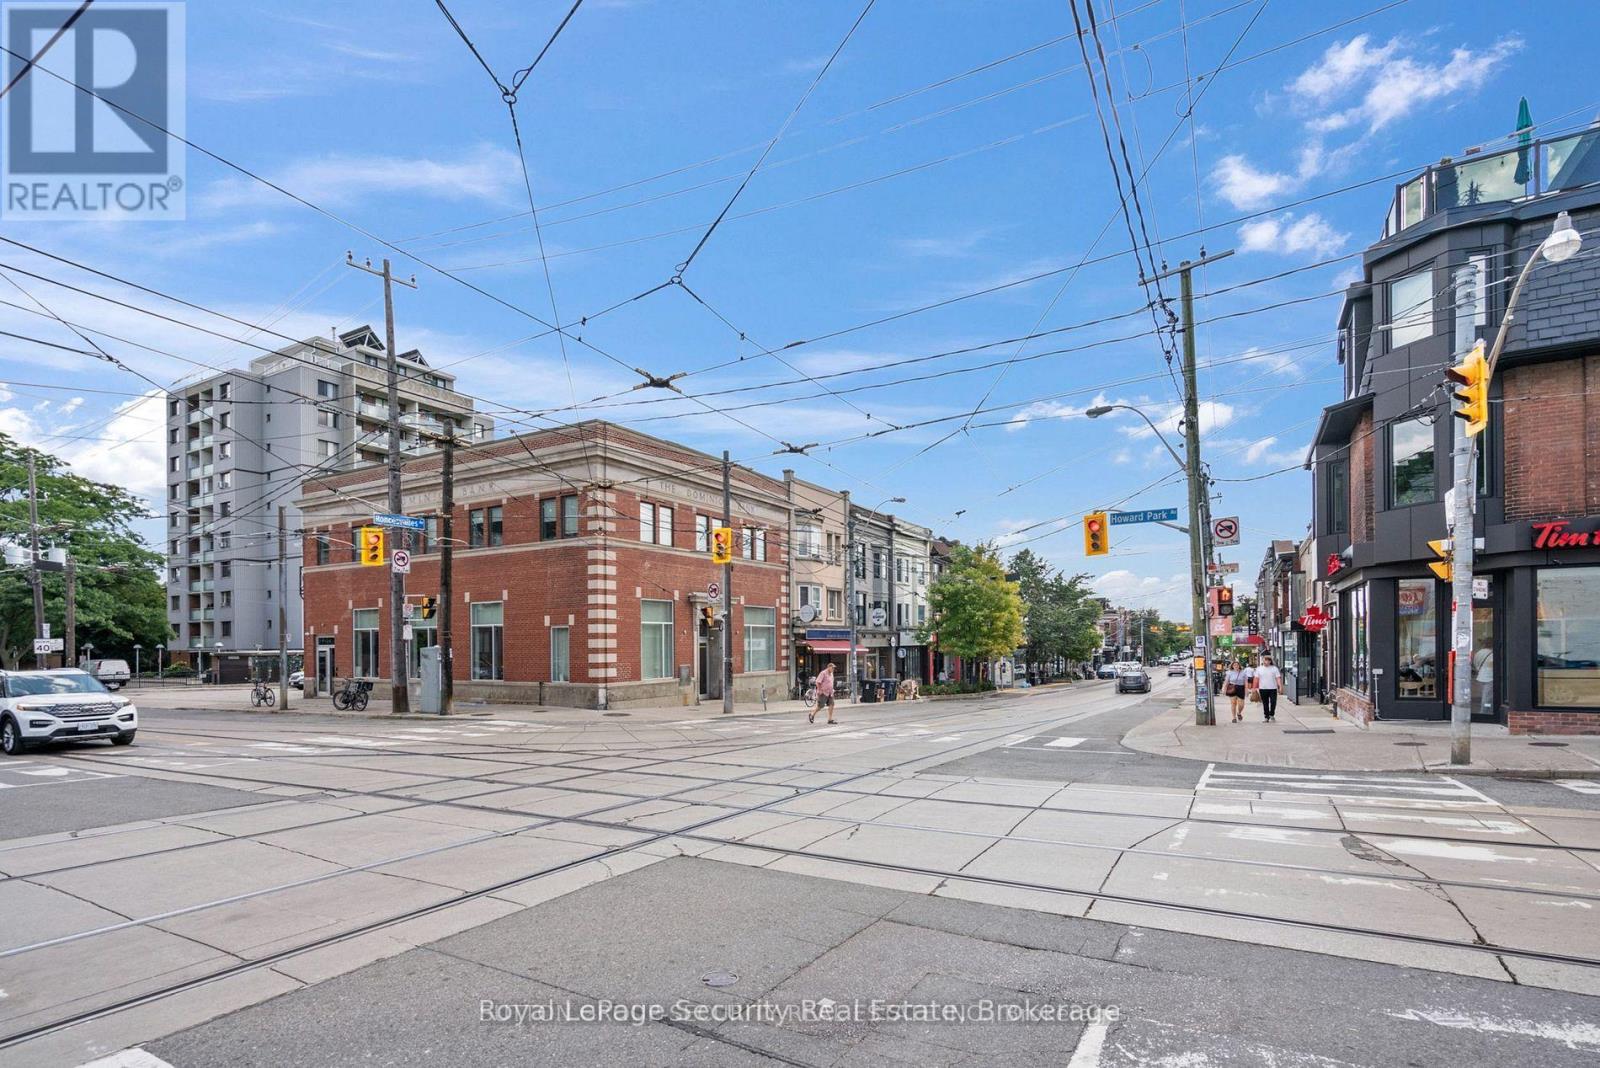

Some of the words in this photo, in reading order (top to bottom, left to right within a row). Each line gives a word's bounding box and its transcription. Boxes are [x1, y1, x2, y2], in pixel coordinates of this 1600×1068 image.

[660, 482, 675, 494] THE
[686, 488, 725, 507] DOMINIO
[1111, 511, 1144, 524] Howard
[1147, 509, 1168, 521] Park
[1532, 521, 1589, 548] Tim
[1301, 614, 1327, 626] Tims
[36, 644, 50, 652] 40
